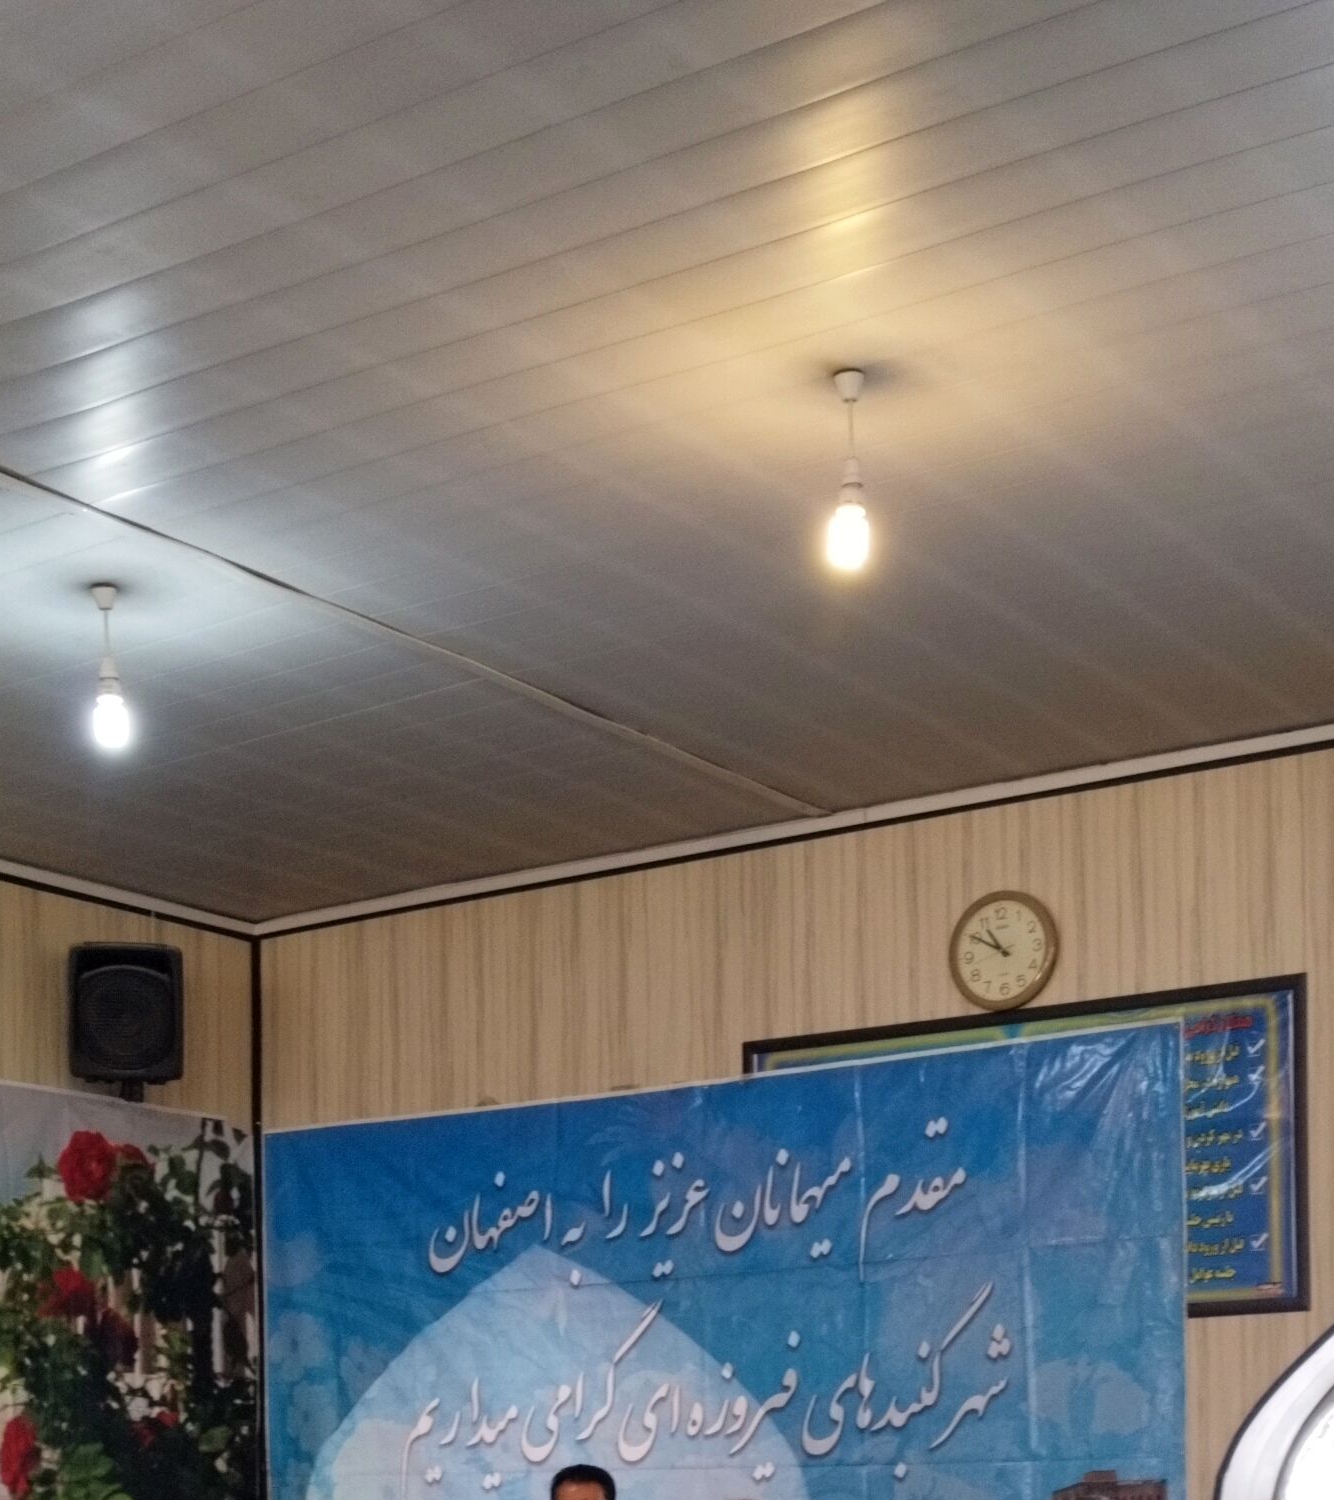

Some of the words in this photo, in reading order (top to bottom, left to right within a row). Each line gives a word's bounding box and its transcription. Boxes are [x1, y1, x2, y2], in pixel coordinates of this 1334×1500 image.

[428, 1170, 553, 1274] اصفهان
[560, 1220, 586, 1288] به
[602, 1169, 628, 1240] را
[639, 1151, 711, 1279] عزیز
[858, 1116, 967, 1284] مقدم
[520, 1298, 664, 1463] گرامی
[929, 1322, 1012, 1450] شهر
